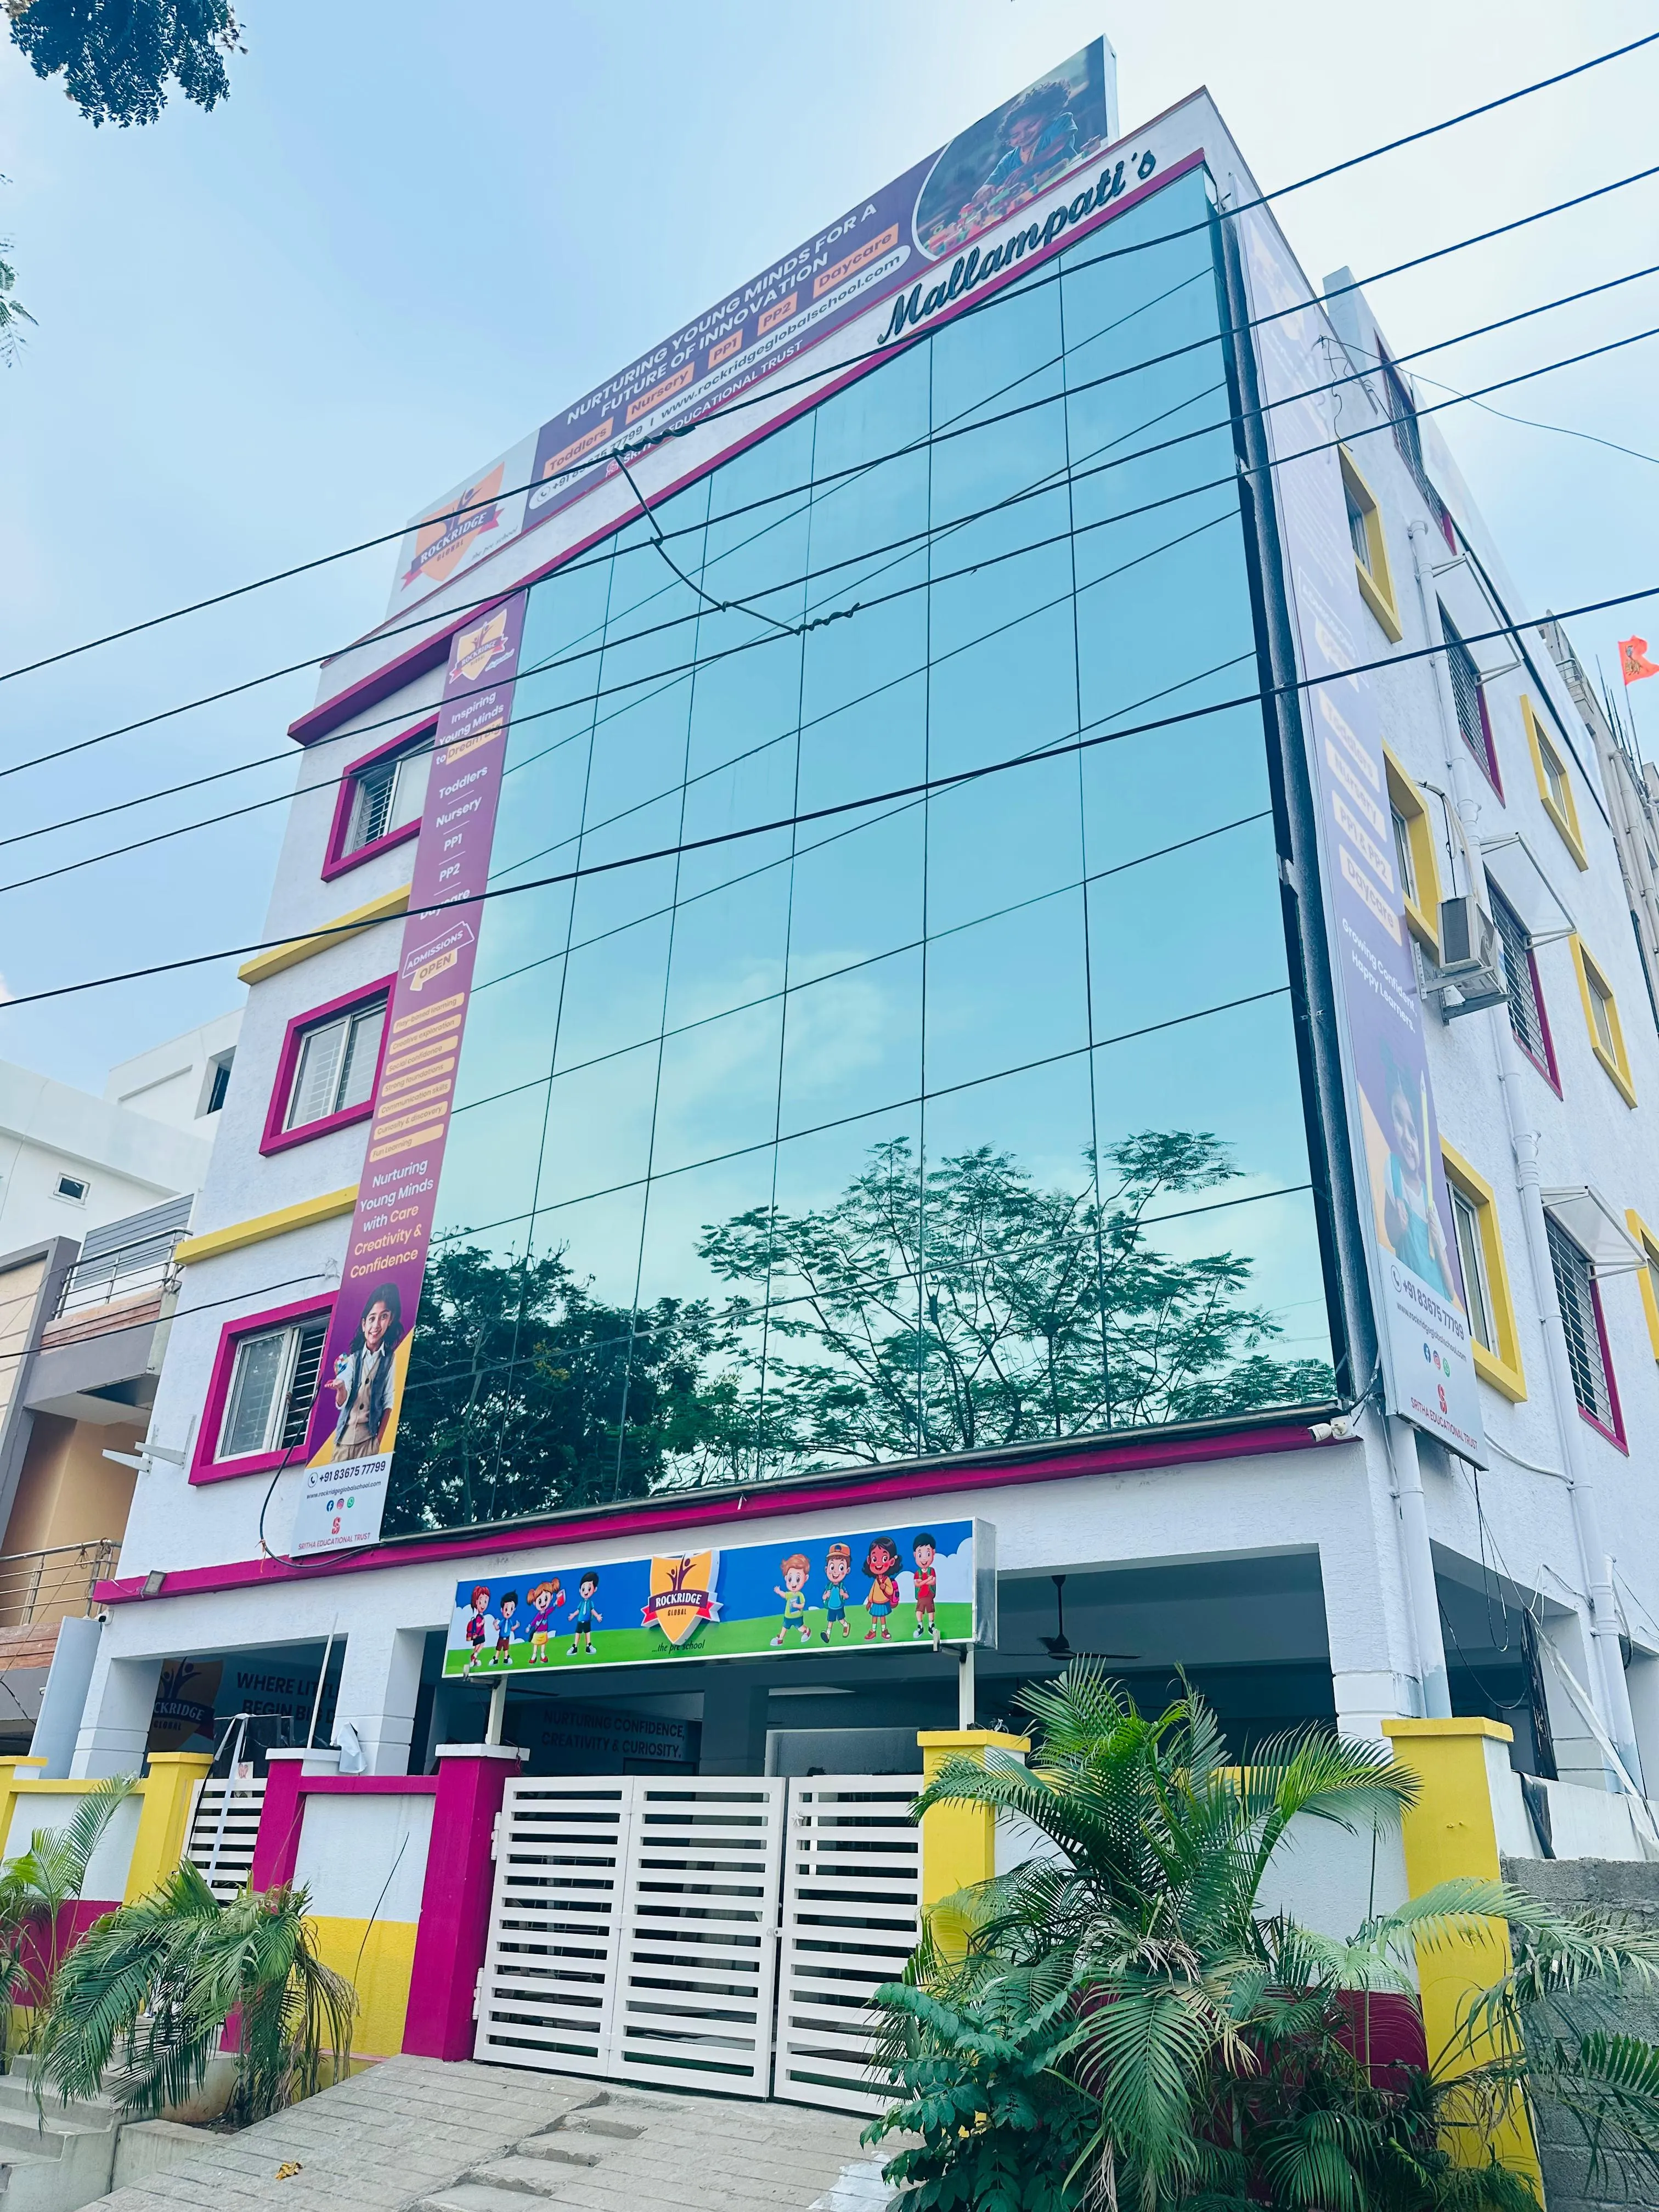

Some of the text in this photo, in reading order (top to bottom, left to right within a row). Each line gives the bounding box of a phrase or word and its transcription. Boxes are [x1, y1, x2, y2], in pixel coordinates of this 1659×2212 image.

[819, 233, 891, 288] Daycare
[877, 150, 1156, 345] Mallampati's
[567, 204, 877, 425] NURTURING YOUNG MINDS FOR A
[763, 301, 791, 327] PP2
[601, 252, 828, 417] FUTURE OF INNOVATION
[714, 337, 737, 360] PP1
[760, 340, 803, 373] TRUST
[552, 474, 569, 489] +91
[661, 255, 900, 419] www.rockridgeglobalschool.com
[631, 370, 689, 415] Nursery
[550, 428, 607, 470] Toddlers
[420, 511, 487, 563] ROCKRIDGE
[437, 539, 464, 562] GLOBAL
[461, 640, 498, 665] ROCKRIDGE
[451, 691, 496, 725] Inspiring
[439, 704, 504, 746] Young Minds
[436, 753, 447, 765] to
[439, 766, 488, 799] Toddlers
[1334, 752, 1377, 820] Nursery
[436, 796, 482, 828] Nursery
[444, 833, 463, 852] PP1
[1340, 804, 1387, 878] PP1 & PP2
[439, 863, 460, 882] PP2
[1347, 857, 1394, 929] Daycare
[406, 930, 464, 970] ADMISSIONS
[419, 953, 452, 979] OPEN
[1342, 917, 1418, 1018] Growing Confident,
[1351, 950, 1416, 1034] Happy Learners.
[419, 1020, 455, 1037] exploration
[408, 1045, 443, 1064] confidence
[385, 1064, 443, 1092] Strong foundations
[381, 1083, 448, 1114] Communication skills
[377, 1120, 405, 1135] Curiosity
[411, 1105, 443, 1122] discovery
[373, 1137, 413, 1158] Fun Learning
[372, 1159, 428, 1188] Nurturing
[360, 1178, 434, 1212] Young Minds
[363, 1205, 419, 1232] with Care
[354, 1223, 422, 1256] Creativity &
[350, 1249, 419, 1278] Confidence
[1403, 1279, 1464, 1340] +91 83675 77799
[1410, 1397, 1478, 1451] SRITHA EDUCATIONAL TRUST
[319, 1460, 386, 1482] +91 83675 77799
[306, 1480, 381, 1499] www.rockridgeglobalschool.com
[298, 1532, 371, 1550] SRITHA EDUCATIONAL TRUST
[655, 1593, 703, 1608] ROCKRIDGE
[668, 1608, 687, 1616] GLOBAL
[668, 1643, 680, 1655] pre
[682, 1639, 706, 1650] school
[236, 1671, 296, 1695] WHERE
[242, 1699, 293, 1716] BEGIN
[543, 1708, 686, 1741] NURTURING CONFIDENCE,
[541, 1731, 681, 1758] CREATIVITY & CURIOSITY.
